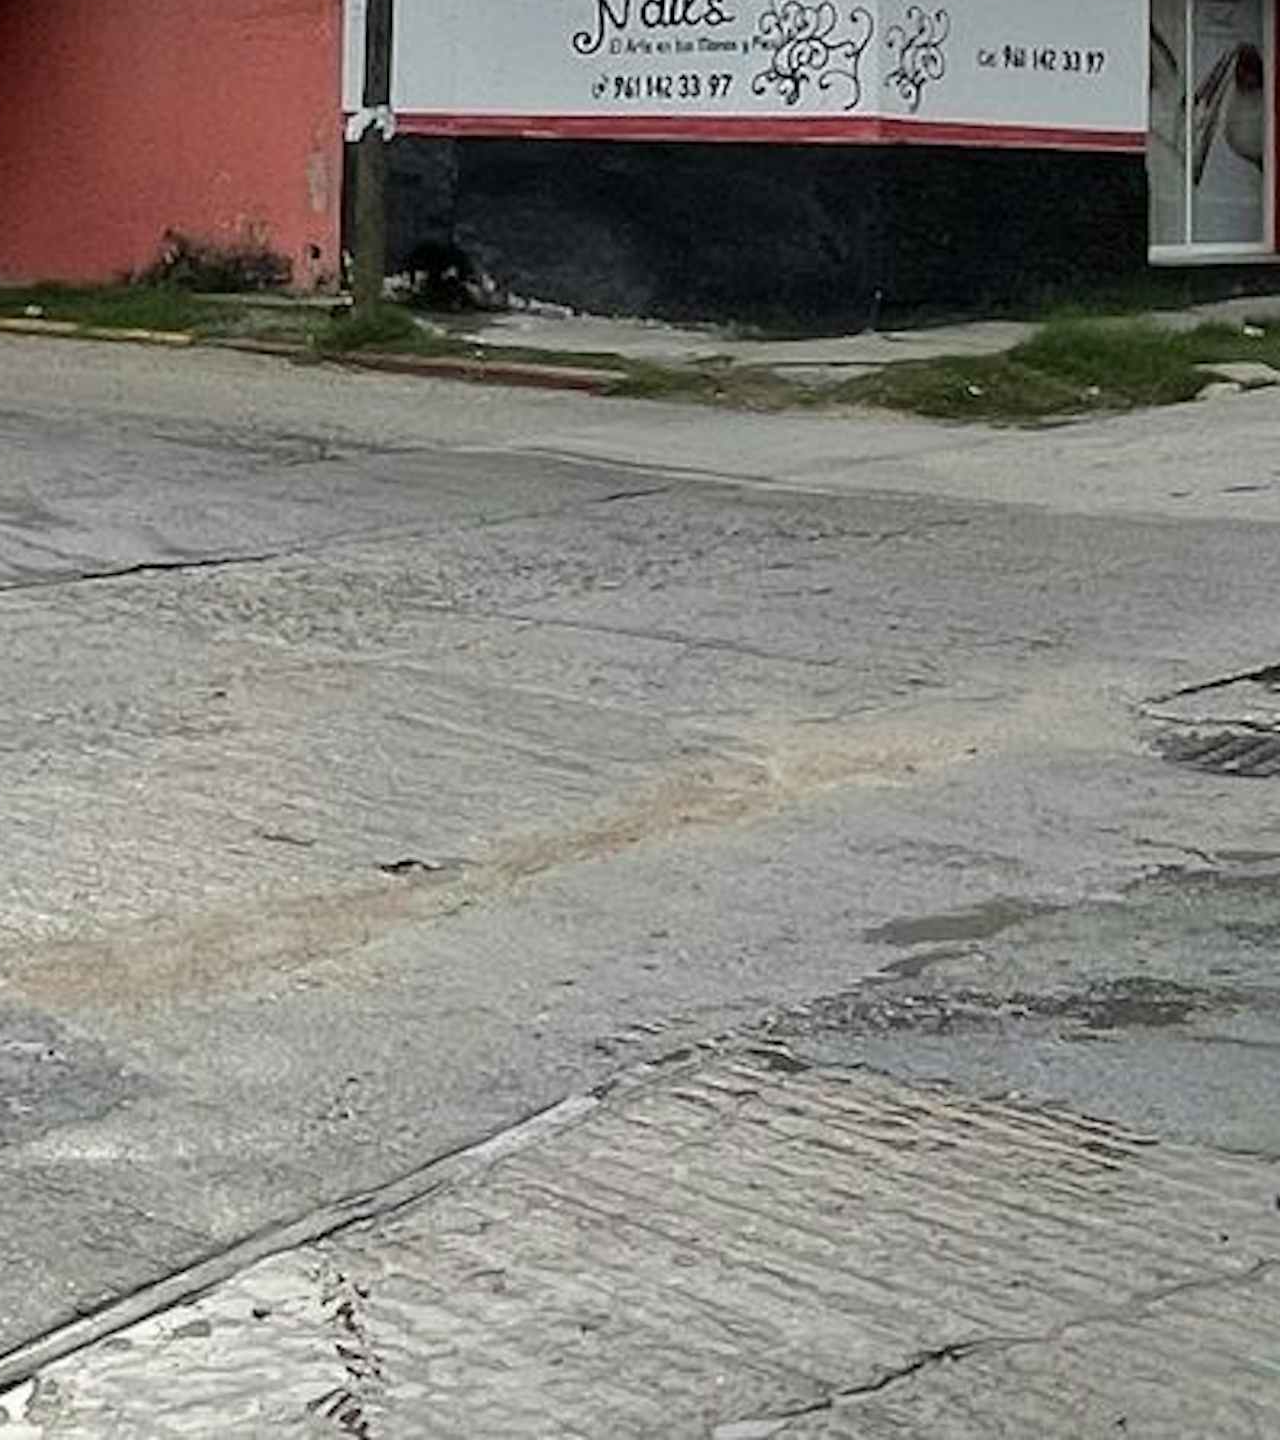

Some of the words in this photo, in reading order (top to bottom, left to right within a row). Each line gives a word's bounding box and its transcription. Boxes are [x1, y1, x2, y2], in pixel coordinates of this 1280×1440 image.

[1032, 48, 1056, 71] 142
[1061, 50, 1081, 72] 33
[614, 75, 640, 99] 961
[646, 75, 672, 98] 142
[678, 74, 701, 98] 33
[707, 74, 733, 97] 97
